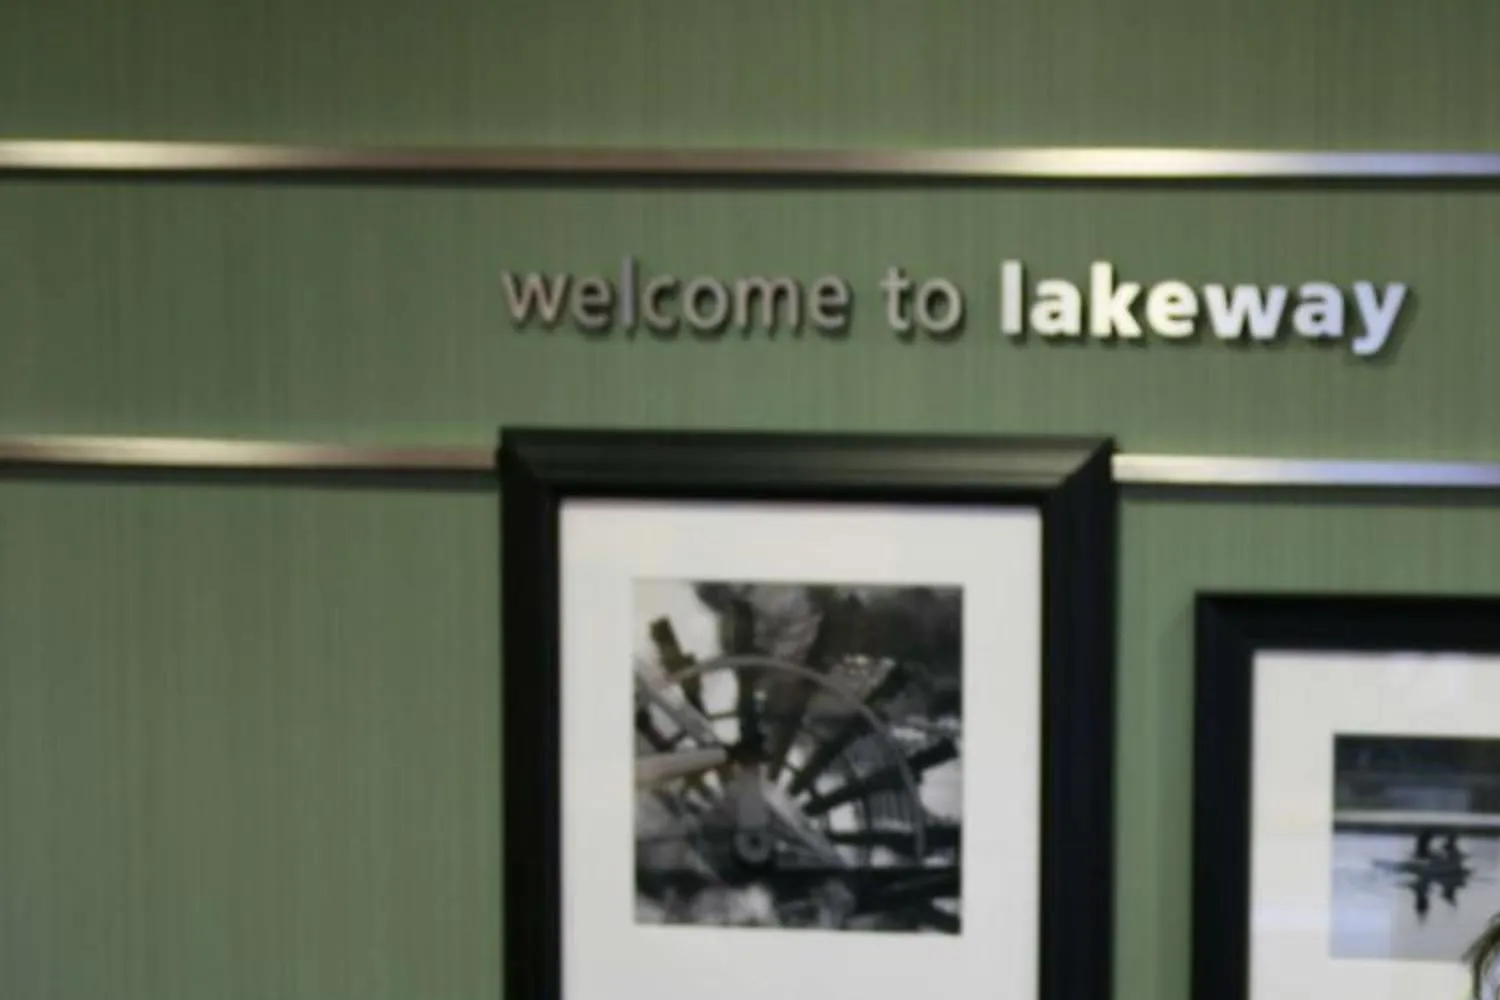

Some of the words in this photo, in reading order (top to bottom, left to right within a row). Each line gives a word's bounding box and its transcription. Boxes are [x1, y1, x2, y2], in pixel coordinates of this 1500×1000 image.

[501, 257, 849, 331] welcome
[881, 265, 963, 331] to
[1001, 260, 1407, 355] lakeway
